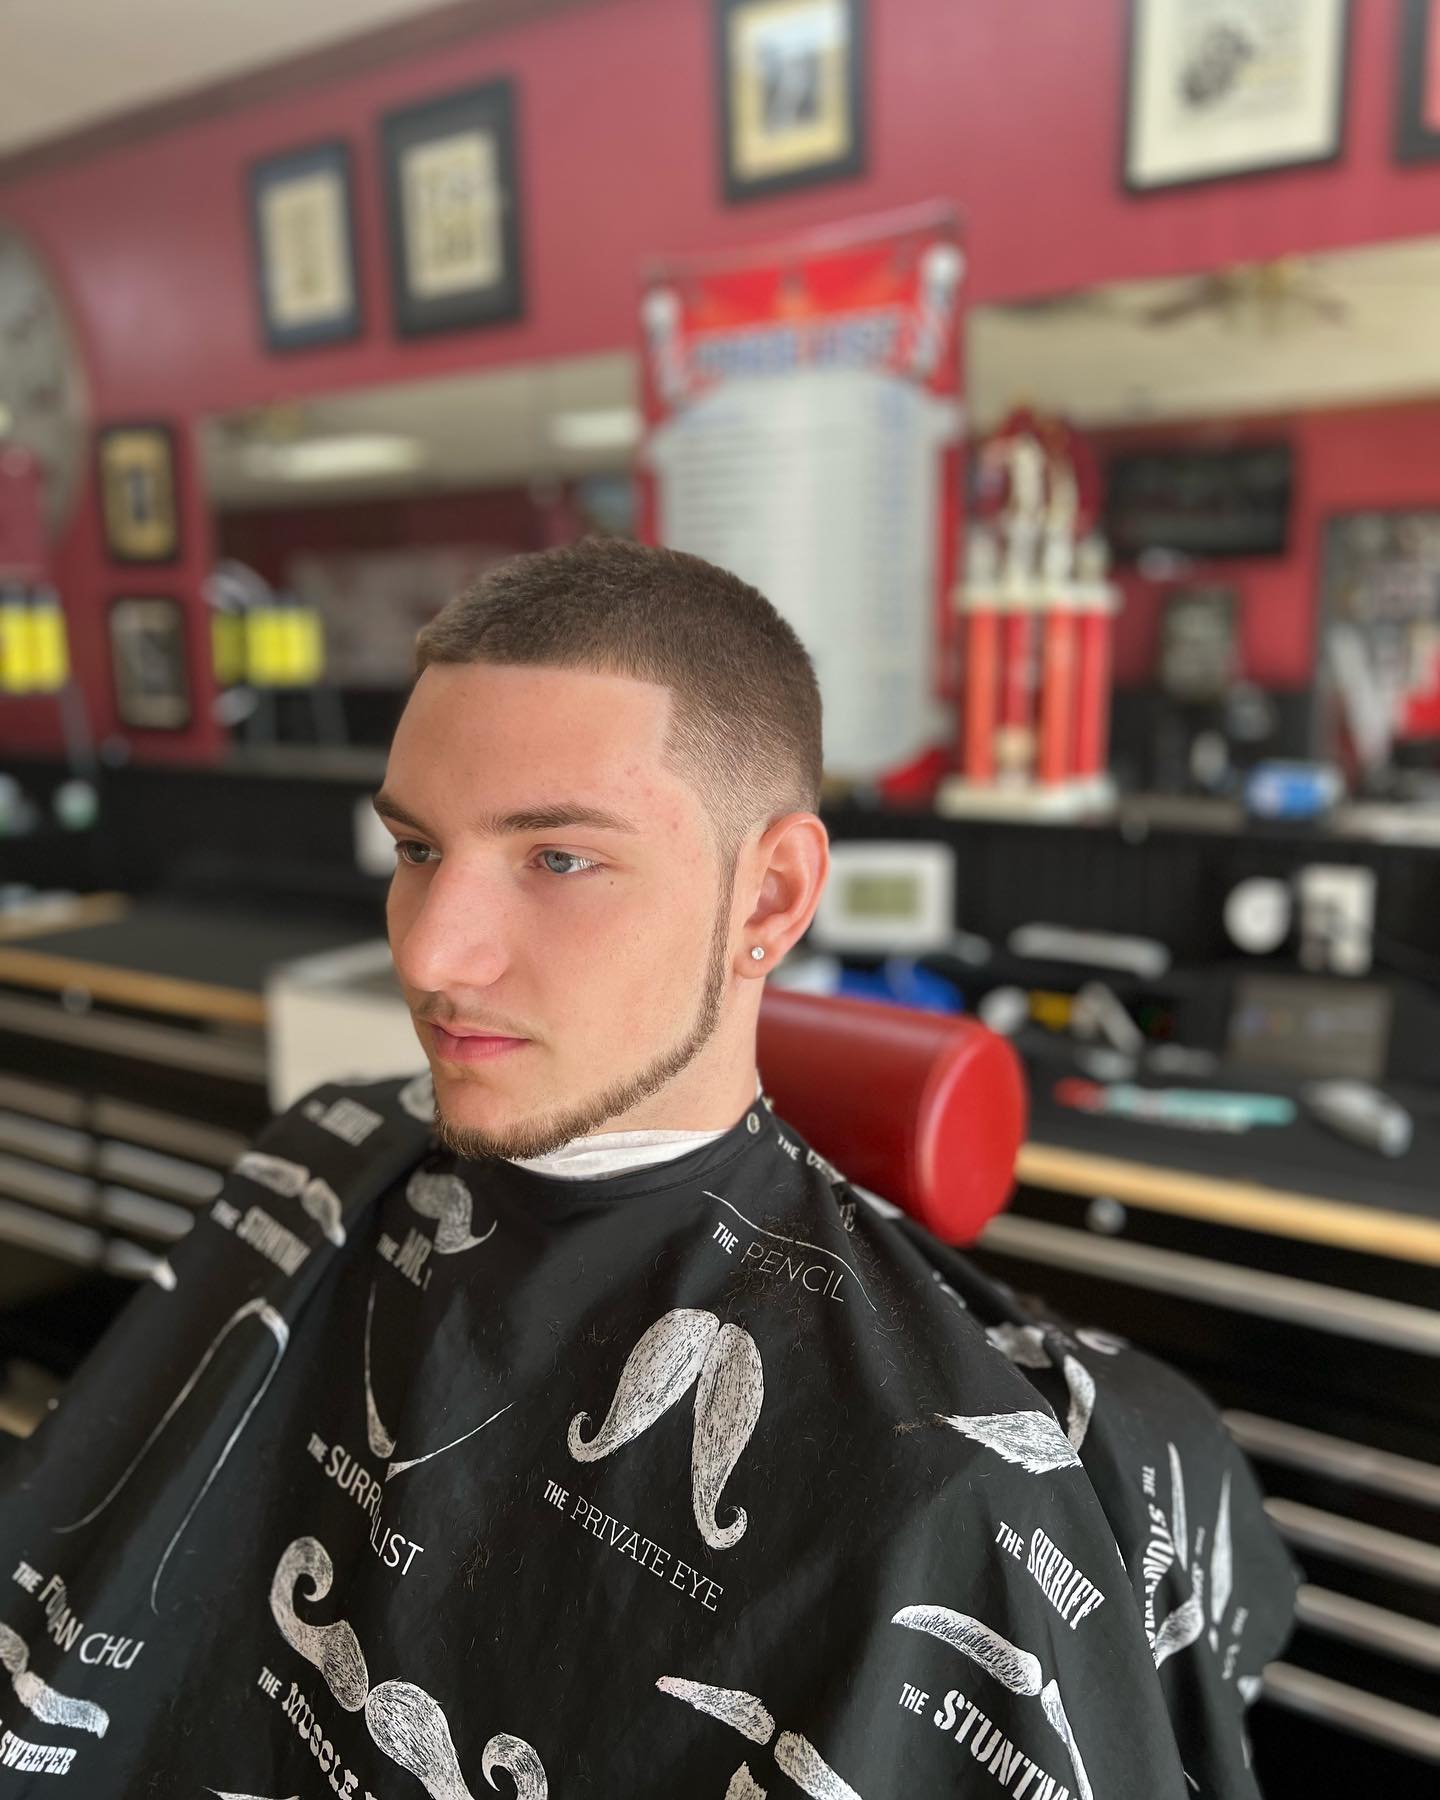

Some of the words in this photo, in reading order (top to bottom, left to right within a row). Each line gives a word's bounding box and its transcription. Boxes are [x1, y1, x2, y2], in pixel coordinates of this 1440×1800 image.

[712, 1221, 739, 1255] THE
[740, 1241, 845, 1302] PENCIL
[307, 1432, 329, 1464] THE
[324, 1445, 425, 1576] SURRLIST
[1142, 1465, 1156, 1498] THE
[543, 1479, 570, 1511] THE
[570, 1495, 672, 1578] PRIVATE
[669, 1559, 724, 1612] EYE
[995, 1520, 1025, 1561] THE
[1026, 1527, 1106, 1630] SHERIFF
[12, 1561, 44, 1593] THE
[80, 1632, 145, 1670] CHU
[0, 1729, 78, 1776] SWEEPER
[257, 1666, 283, 1699] THE
[281, 1682, 359, 1800] MUSCLE
[898, 1682, 930, 1716] THE
[933, 1689, 1078, 1800] STUNTM
